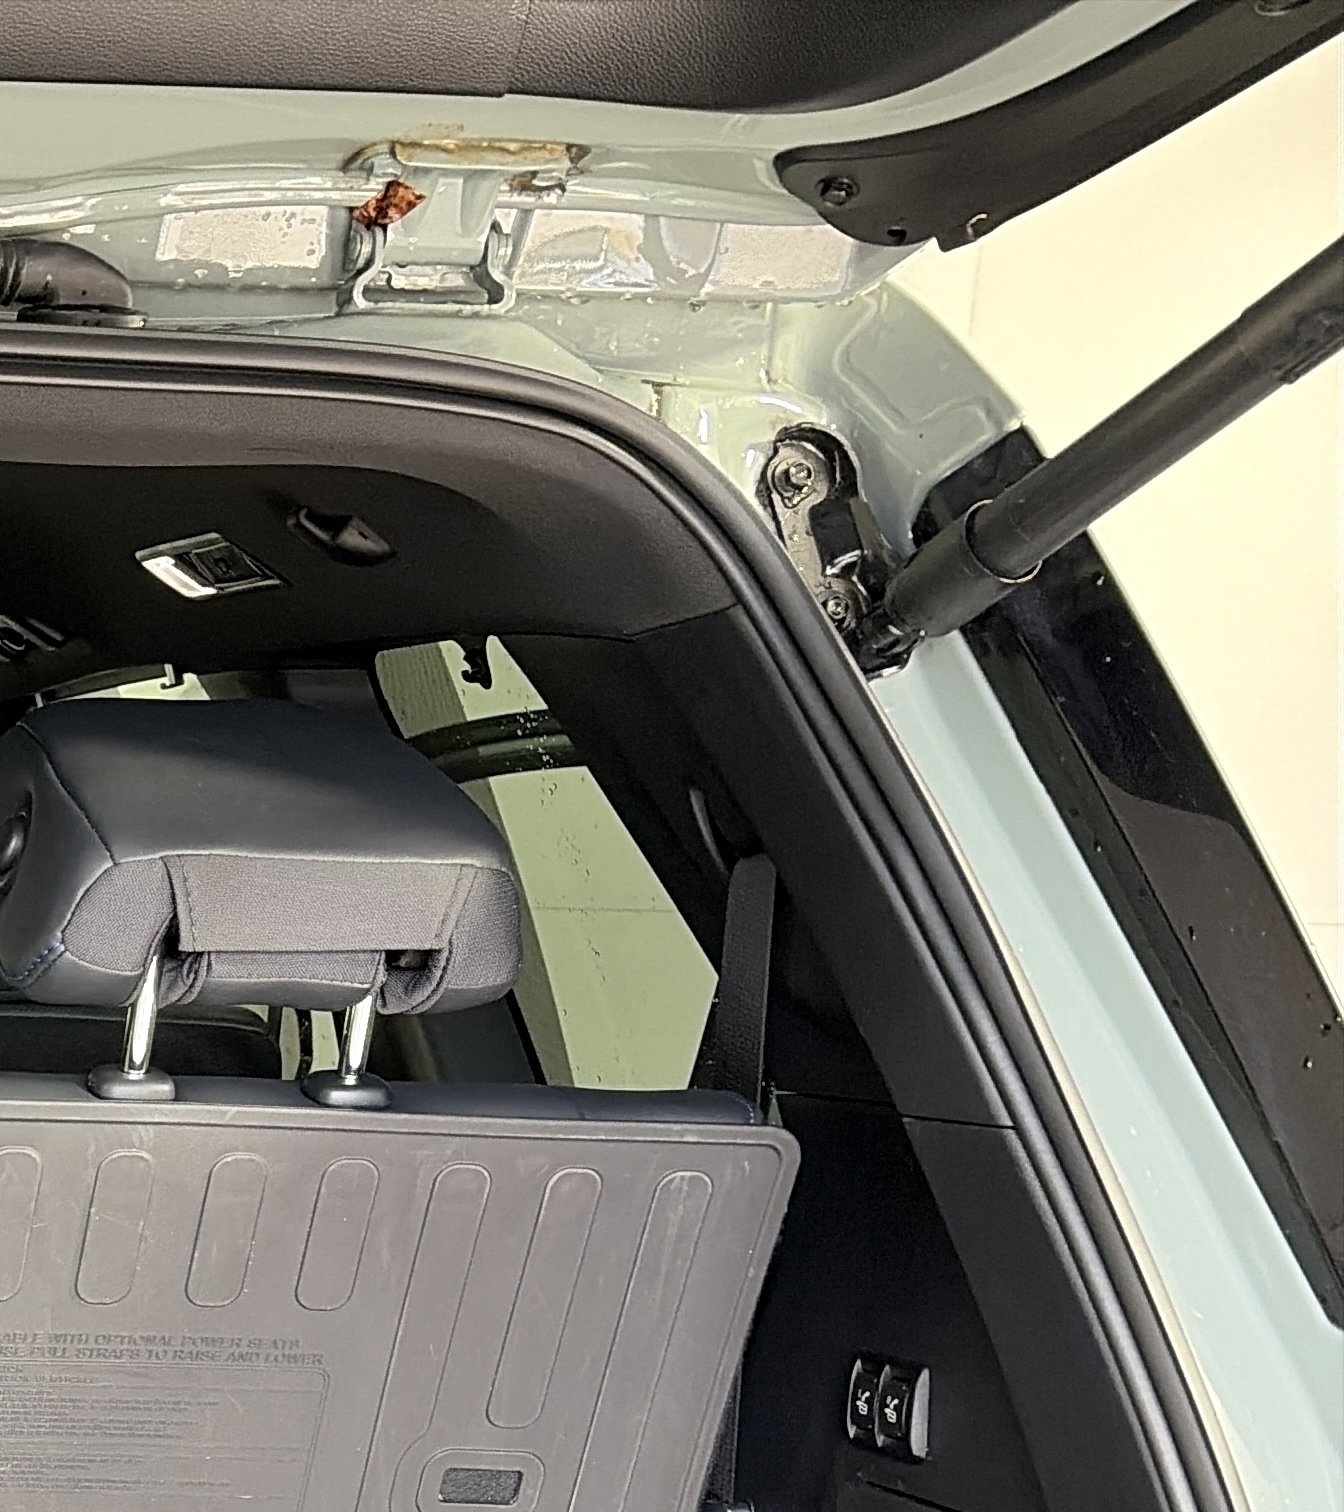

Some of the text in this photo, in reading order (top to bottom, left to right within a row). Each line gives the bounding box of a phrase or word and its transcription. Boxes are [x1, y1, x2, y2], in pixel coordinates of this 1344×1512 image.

[48, 1332, 89, 1345] WITH
[94, 1333, 173, 1347] OPTIONAL
[180, 1335, 242, 1348] POWER
[75, 1347, 141, 1360] STRAPS
[146, 1348, 167, 1361] TO
[172, 1348, 222, 1362] RAISE
[224, 1350, 260, 1363] AND
[263, 1351, 324, 1365] LOWER
